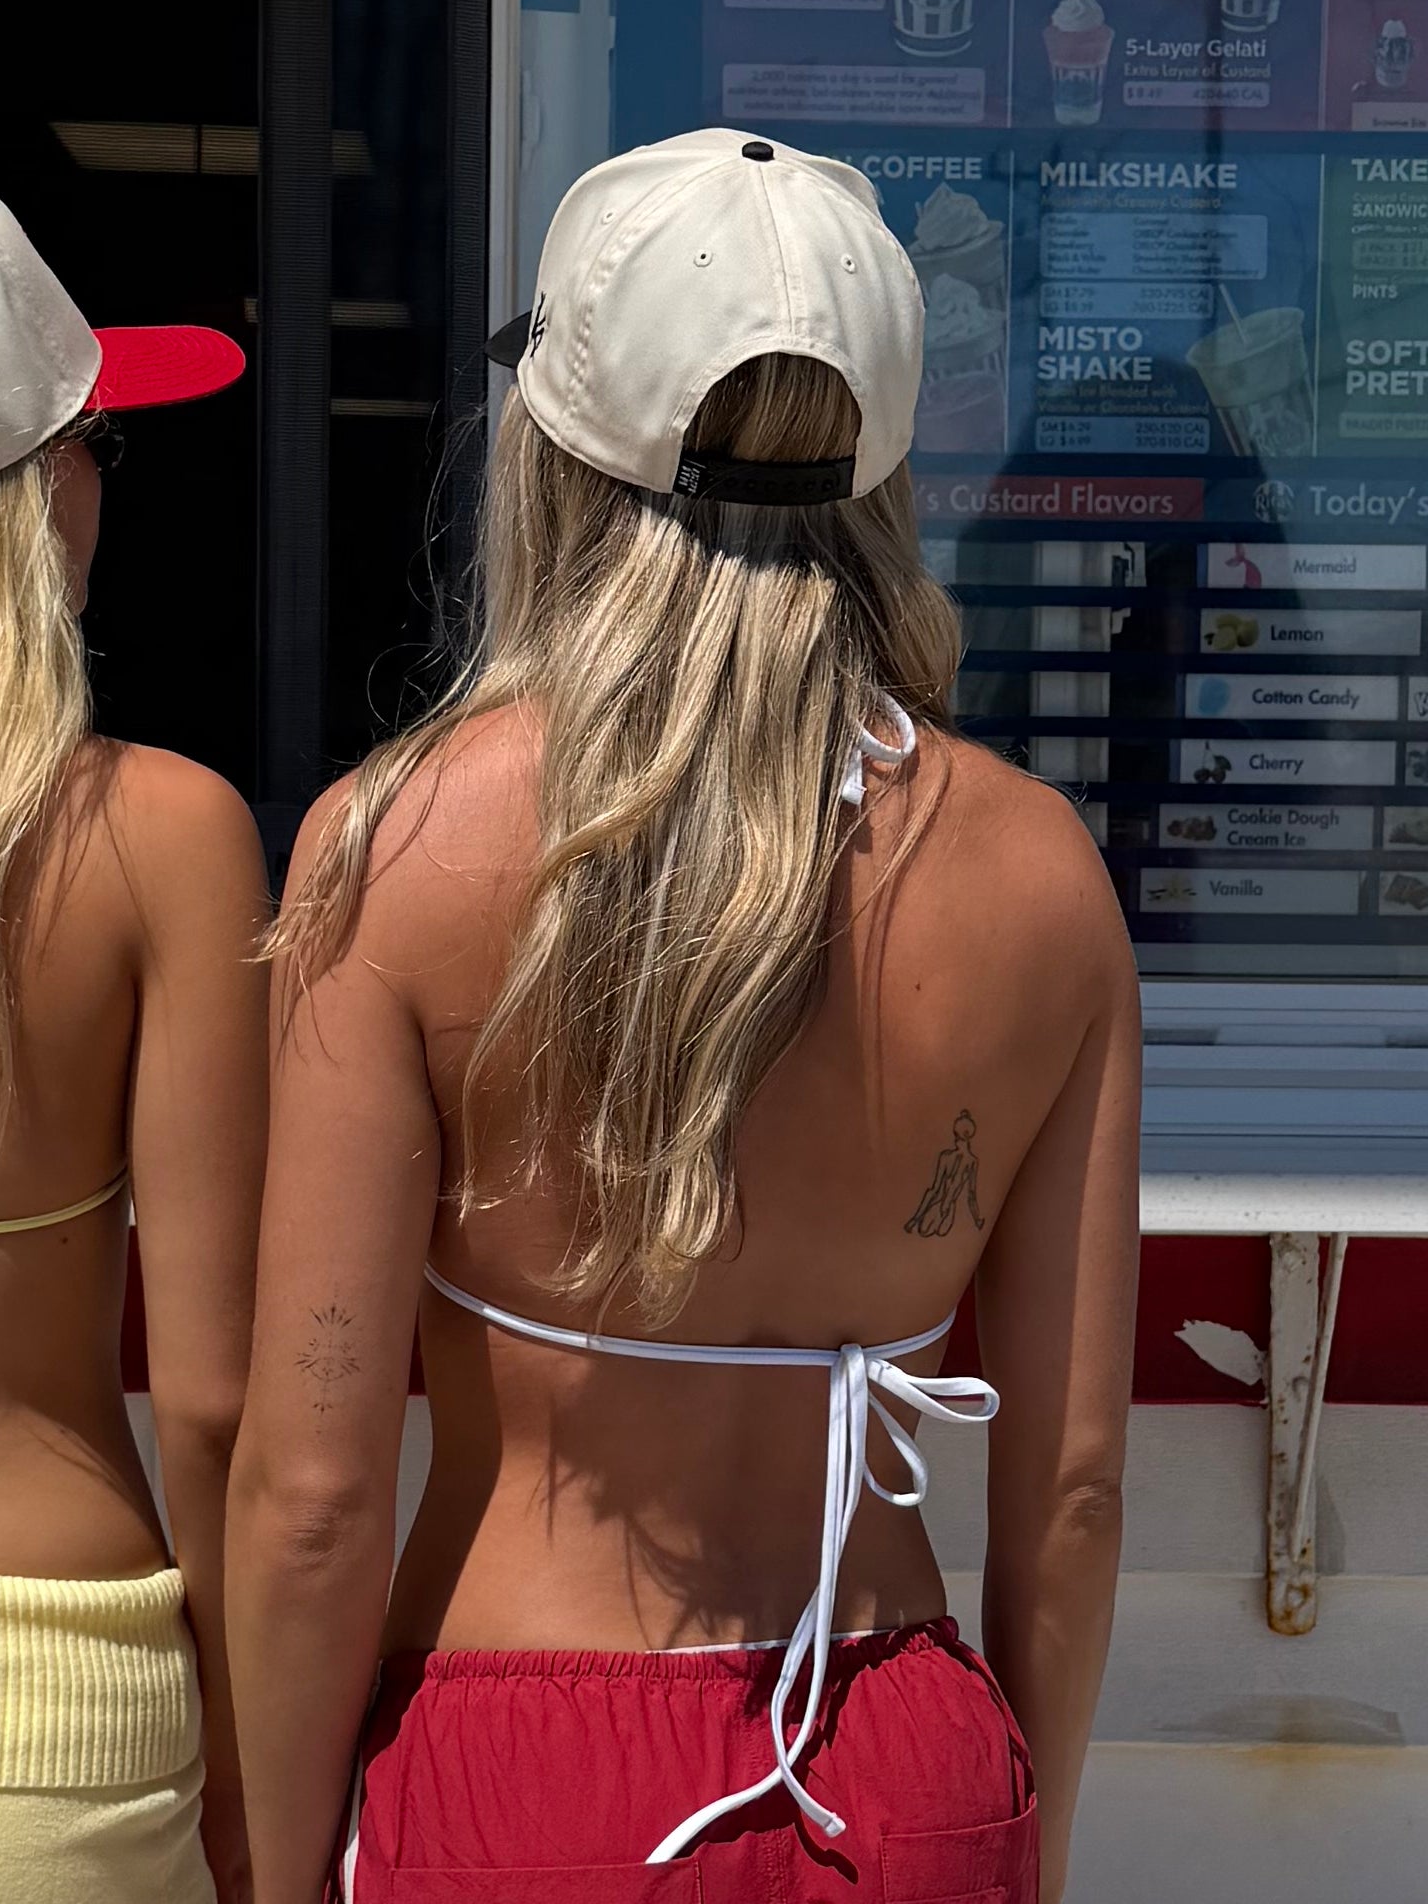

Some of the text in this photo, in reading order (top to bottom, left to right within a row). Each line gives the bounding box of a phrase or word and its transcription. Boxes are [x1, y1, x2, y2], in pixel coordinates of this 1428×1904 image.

[1125, 39, 1267, 59] 5-Layer Gelati
[867, 157, 982, 180] COFFEE
[1041, 162, 1238, 188] MILKSHAKE
[1352, 158, 1428, 182] TAKE
[1352, 284, 1398, 299] PINTS
[1038, 326, 1143, 351] MISTO
[1038, 356, 1152, 381] SHAKE
[950, 484, 1174, 515] Custard Flavors
[1293, 557, 1357, 575] Mermaid
[1271, 626, 1324, 643] Lemon
[1252, 689, 1360, 709] Cotton Candy
[1249, 755, 1304, 774] Cherry
[1227, 809, 1340, 830] Cookie Dough
[1227, 831, 1306, 848] Cream Ice
[1209, 880, 1263, 898] Vanilla
